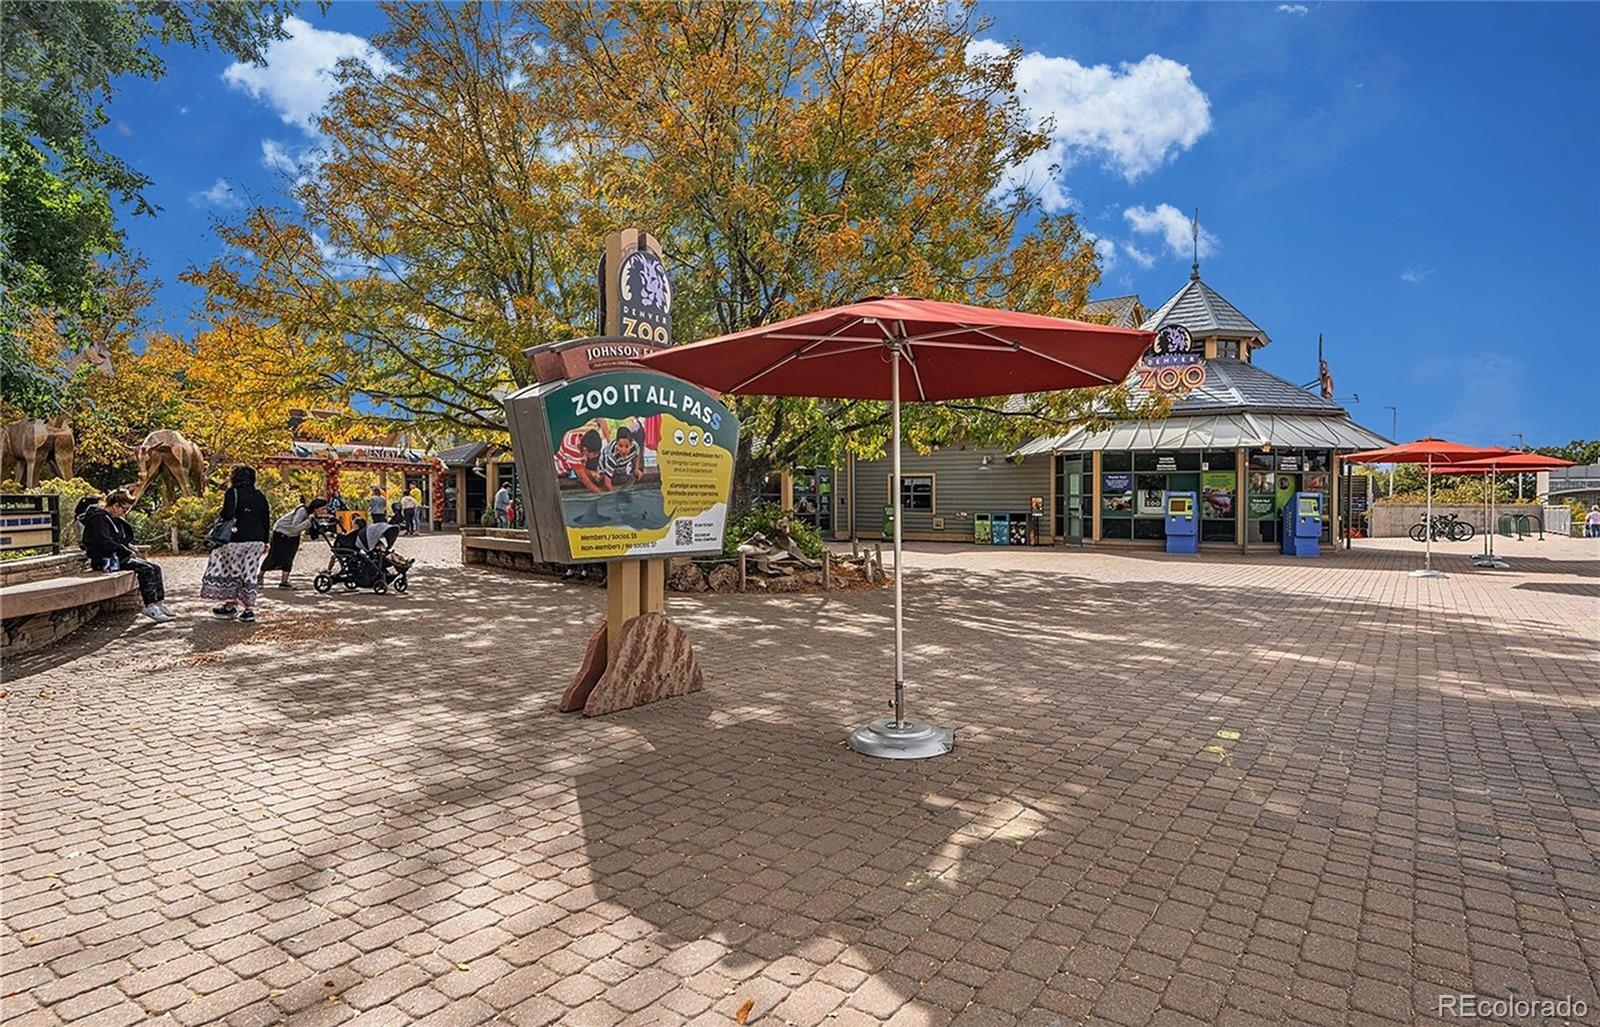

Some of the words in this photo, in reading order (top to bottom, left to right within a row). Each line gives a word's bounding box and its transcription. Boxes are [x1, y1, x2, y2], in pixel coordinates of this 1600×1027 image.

[623, 305, 667, 325] DENVER
[622, 316, 669, 344] ZOO
[587, 345, 640, 361] JOHNSON
[1147, 356, 1195, 366] DENVER
[1136, 364, 1206, 391] ZOO
[571, 385, 618, 416] ZOO
[623, 384, 641, 403] IT
[646, 385, 678, 409] ALL
[682, 394, 721, 430] PASS
[581, 533, 607, 541] Members
[581, 543, 620, 551] Non-Members
